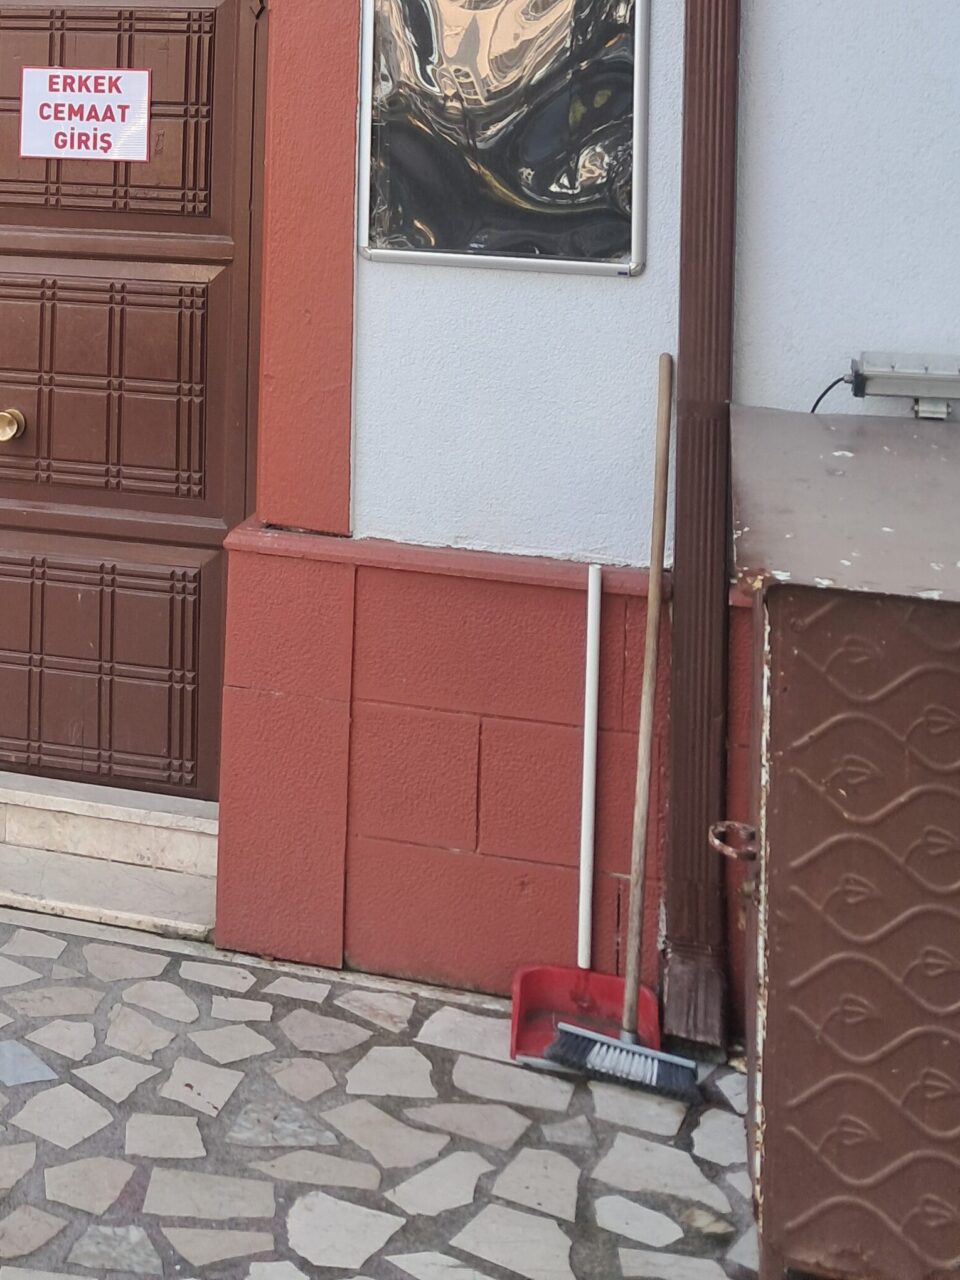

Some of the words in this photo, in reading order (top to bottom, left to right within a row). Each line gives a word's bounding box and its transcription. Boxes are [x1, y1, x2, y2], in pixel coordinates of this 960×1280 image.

[48, 74, 122, 94] ERKEK
[38, 102, 130, 123] CEMAAT
[54, 126, 113, 153] GİRİŞ
